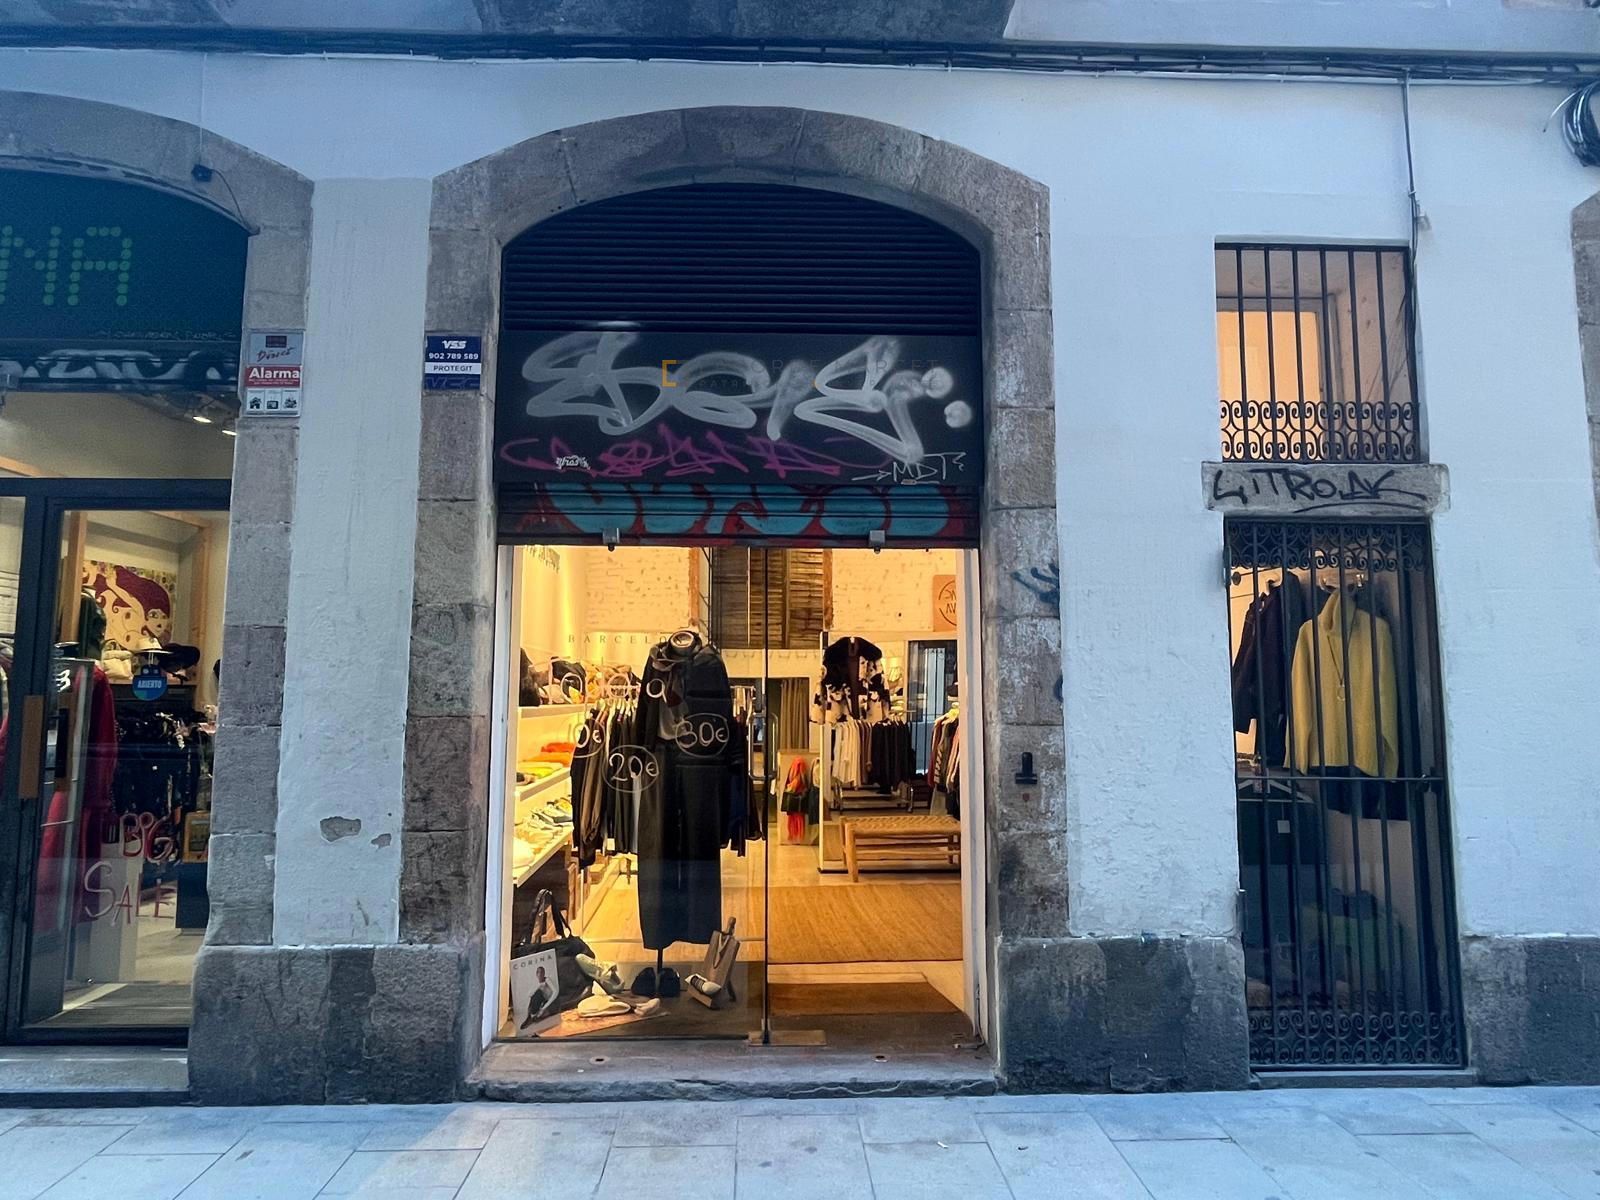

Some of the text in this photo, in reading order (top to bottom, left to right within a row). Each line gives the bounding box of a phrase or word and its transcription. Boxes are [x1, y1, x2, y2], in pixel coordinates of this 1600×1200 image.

[428, 352, 479, 360] 902 789 589
[249, 367, 300, 379] Alarma
[673, 719, 729, 749] 30€
[608, 752, 660, 782] 20€
